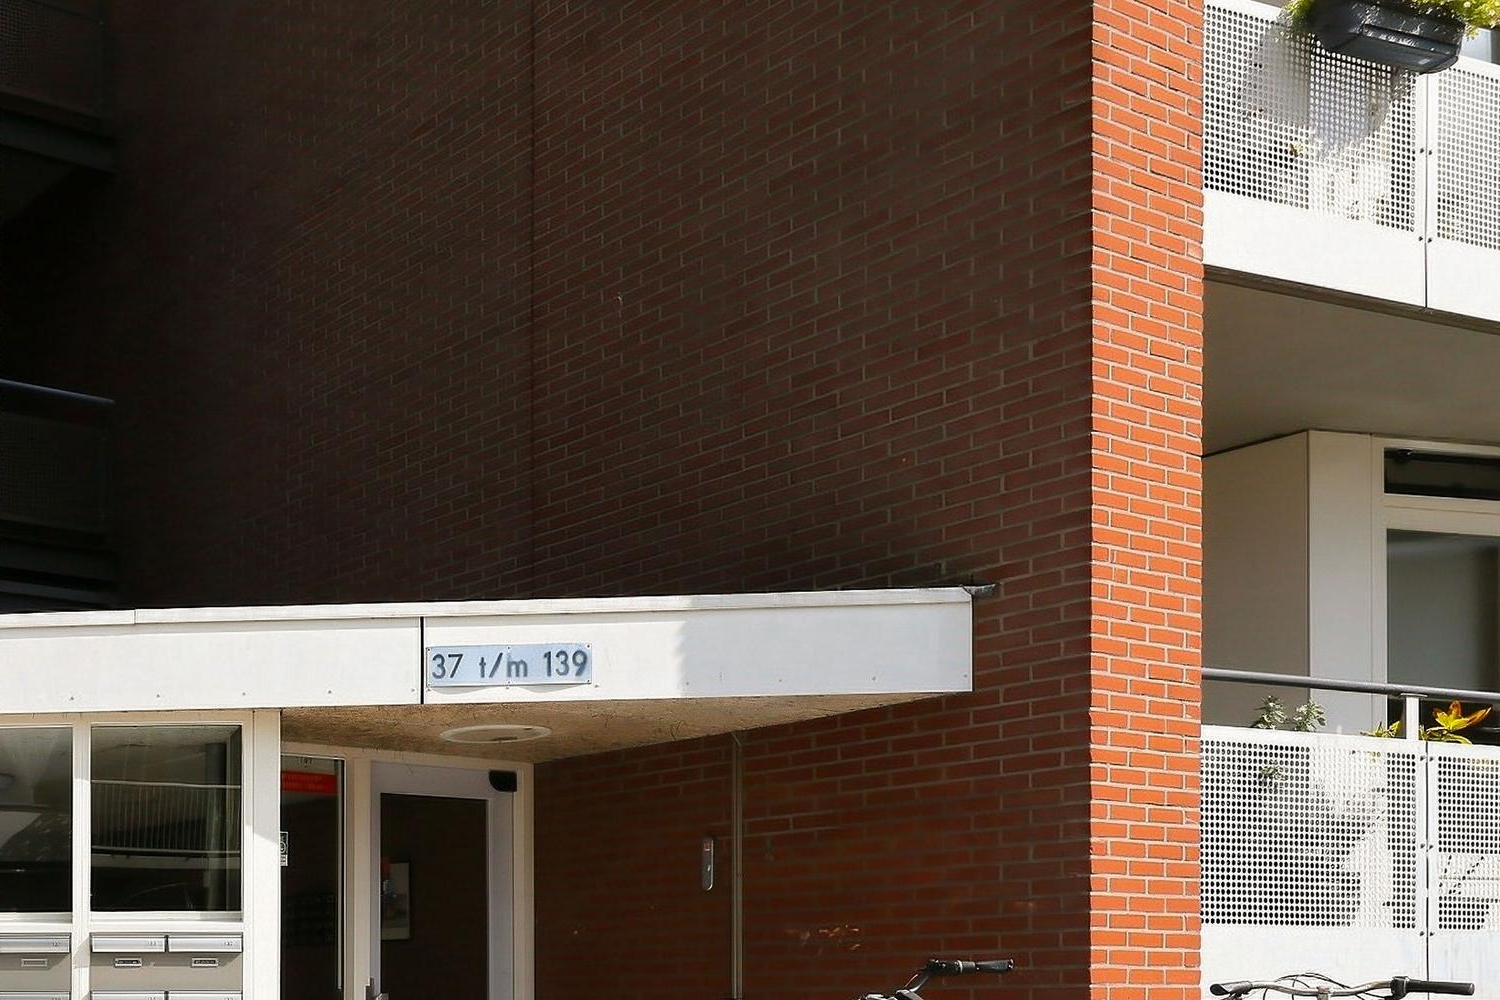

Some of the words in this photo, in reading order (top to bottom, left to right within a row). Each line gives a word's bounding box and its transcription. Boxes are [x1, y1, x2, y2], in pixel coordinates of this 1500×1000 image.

[431, 652, 464, 680] 37
[477, 651, 529, 679] t/m
[542, 649, 589, 678] 139
